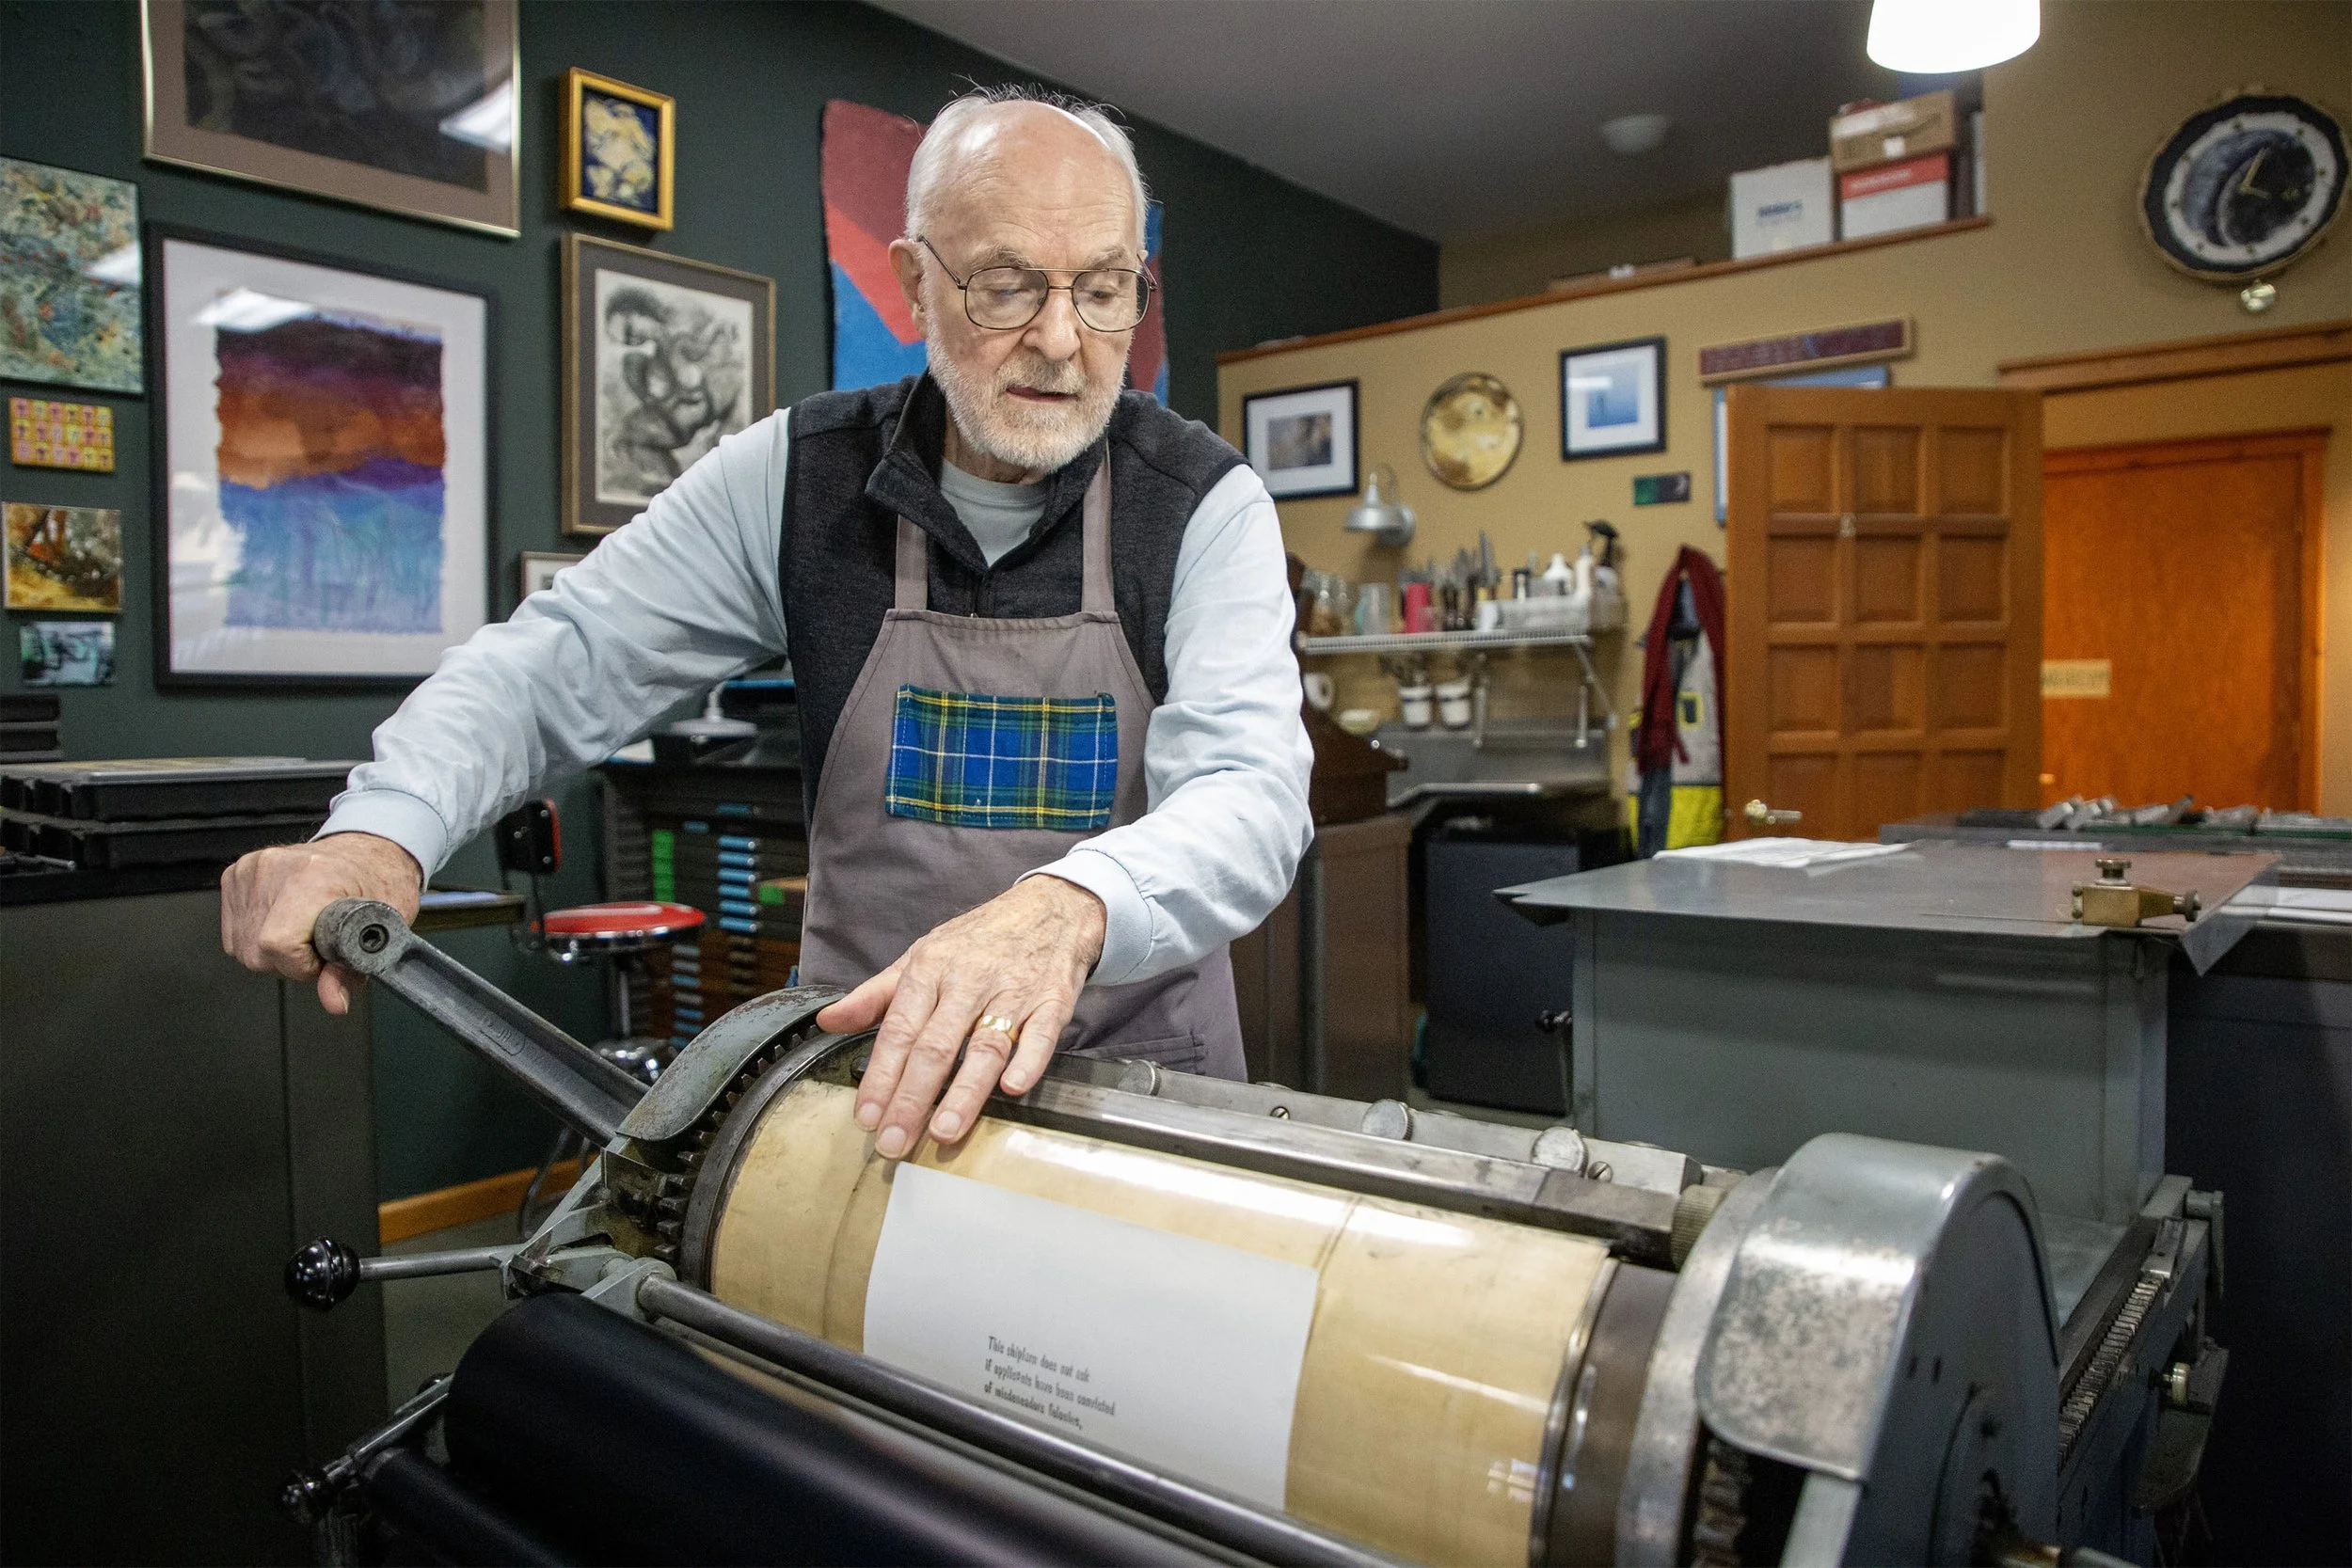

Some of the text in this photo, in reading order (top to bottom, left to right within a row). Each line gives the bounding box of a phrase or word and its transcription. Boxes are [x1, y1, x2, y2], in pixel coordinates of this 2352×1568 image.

[985, 1358, 992, 1371] if
[988, 1336, 1004, 1354] This
[1041, 1354, 1057, 1371] does
[1060, 1365, 1073, 1377] not
[1075, 1368, 1090, 1382] ask
[984, 1381, 993, 1394] of
